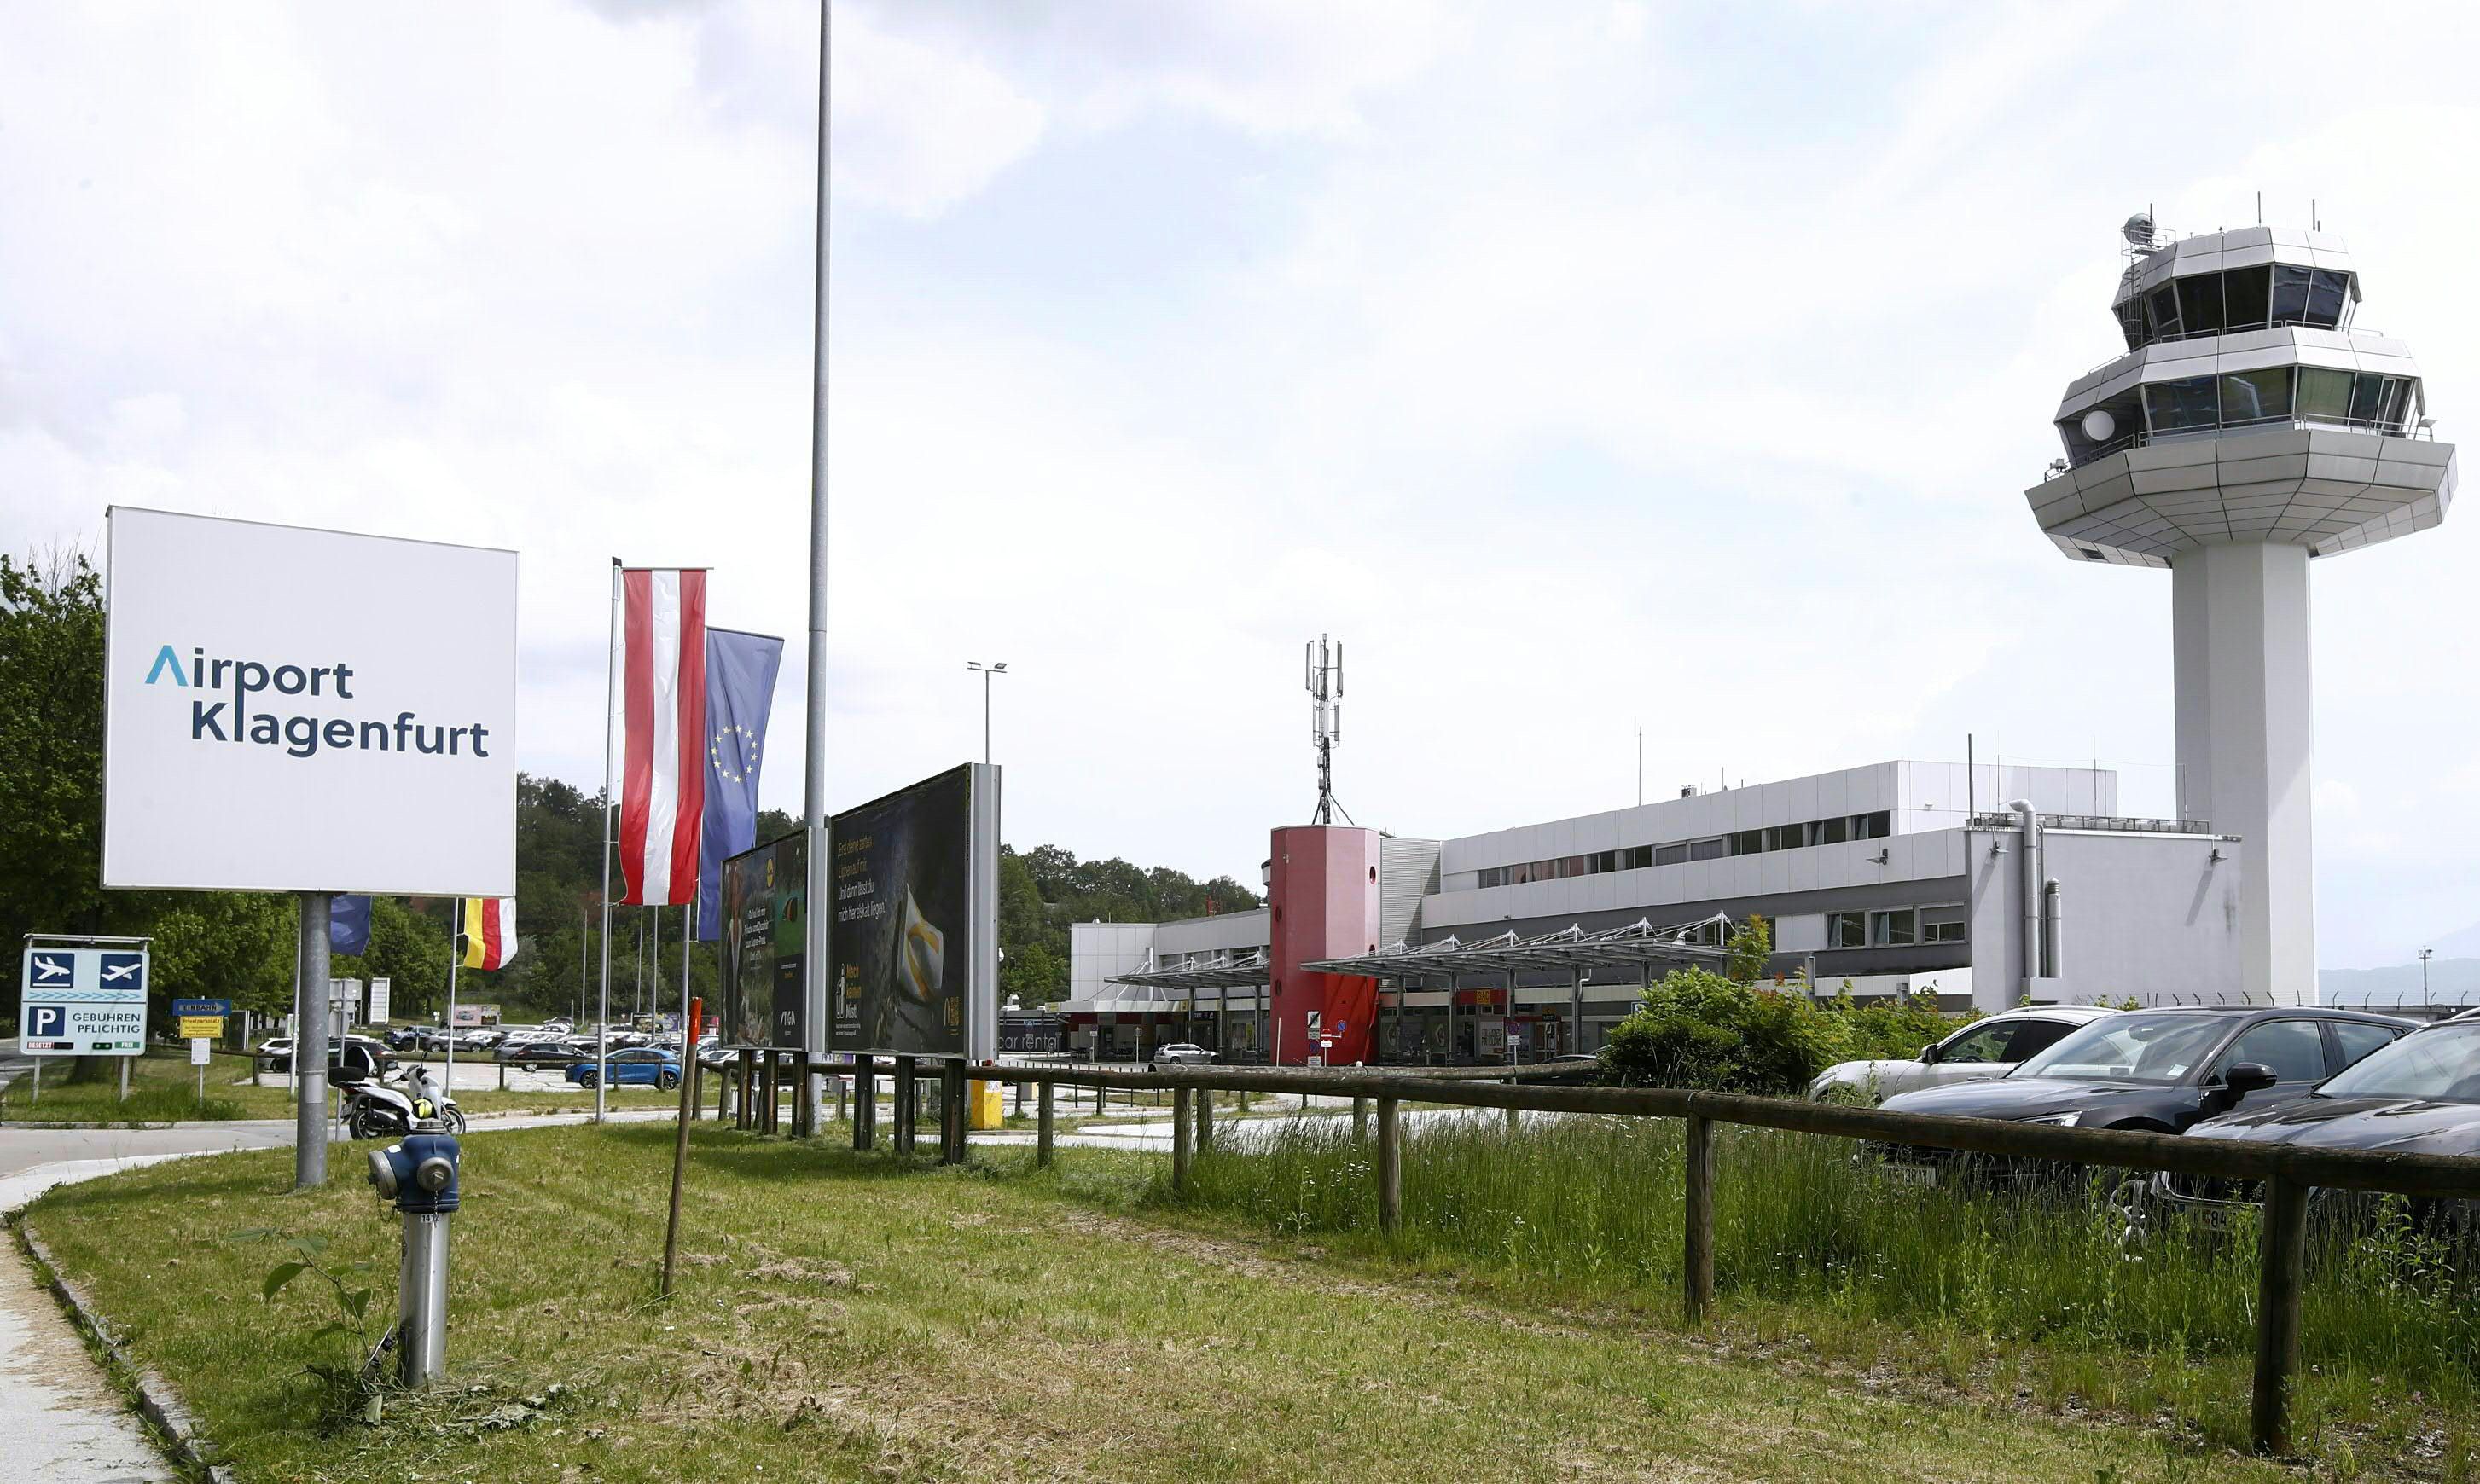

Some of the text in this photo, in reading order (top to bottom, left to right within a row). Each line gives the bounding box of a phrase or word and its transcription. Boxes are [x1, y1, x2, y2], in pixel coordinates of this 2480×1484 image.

[144, 645, 354, 742] Airport
[192, 700, 489, 757] Klagenfurt
[37, 1008, 57, 1035] P
[73, 1012, 141, 1022] GEBÜHREN
[78, 1024, 141, 1034] PFLICHTIG
[998, 1032, 1060, 1050] car renta
